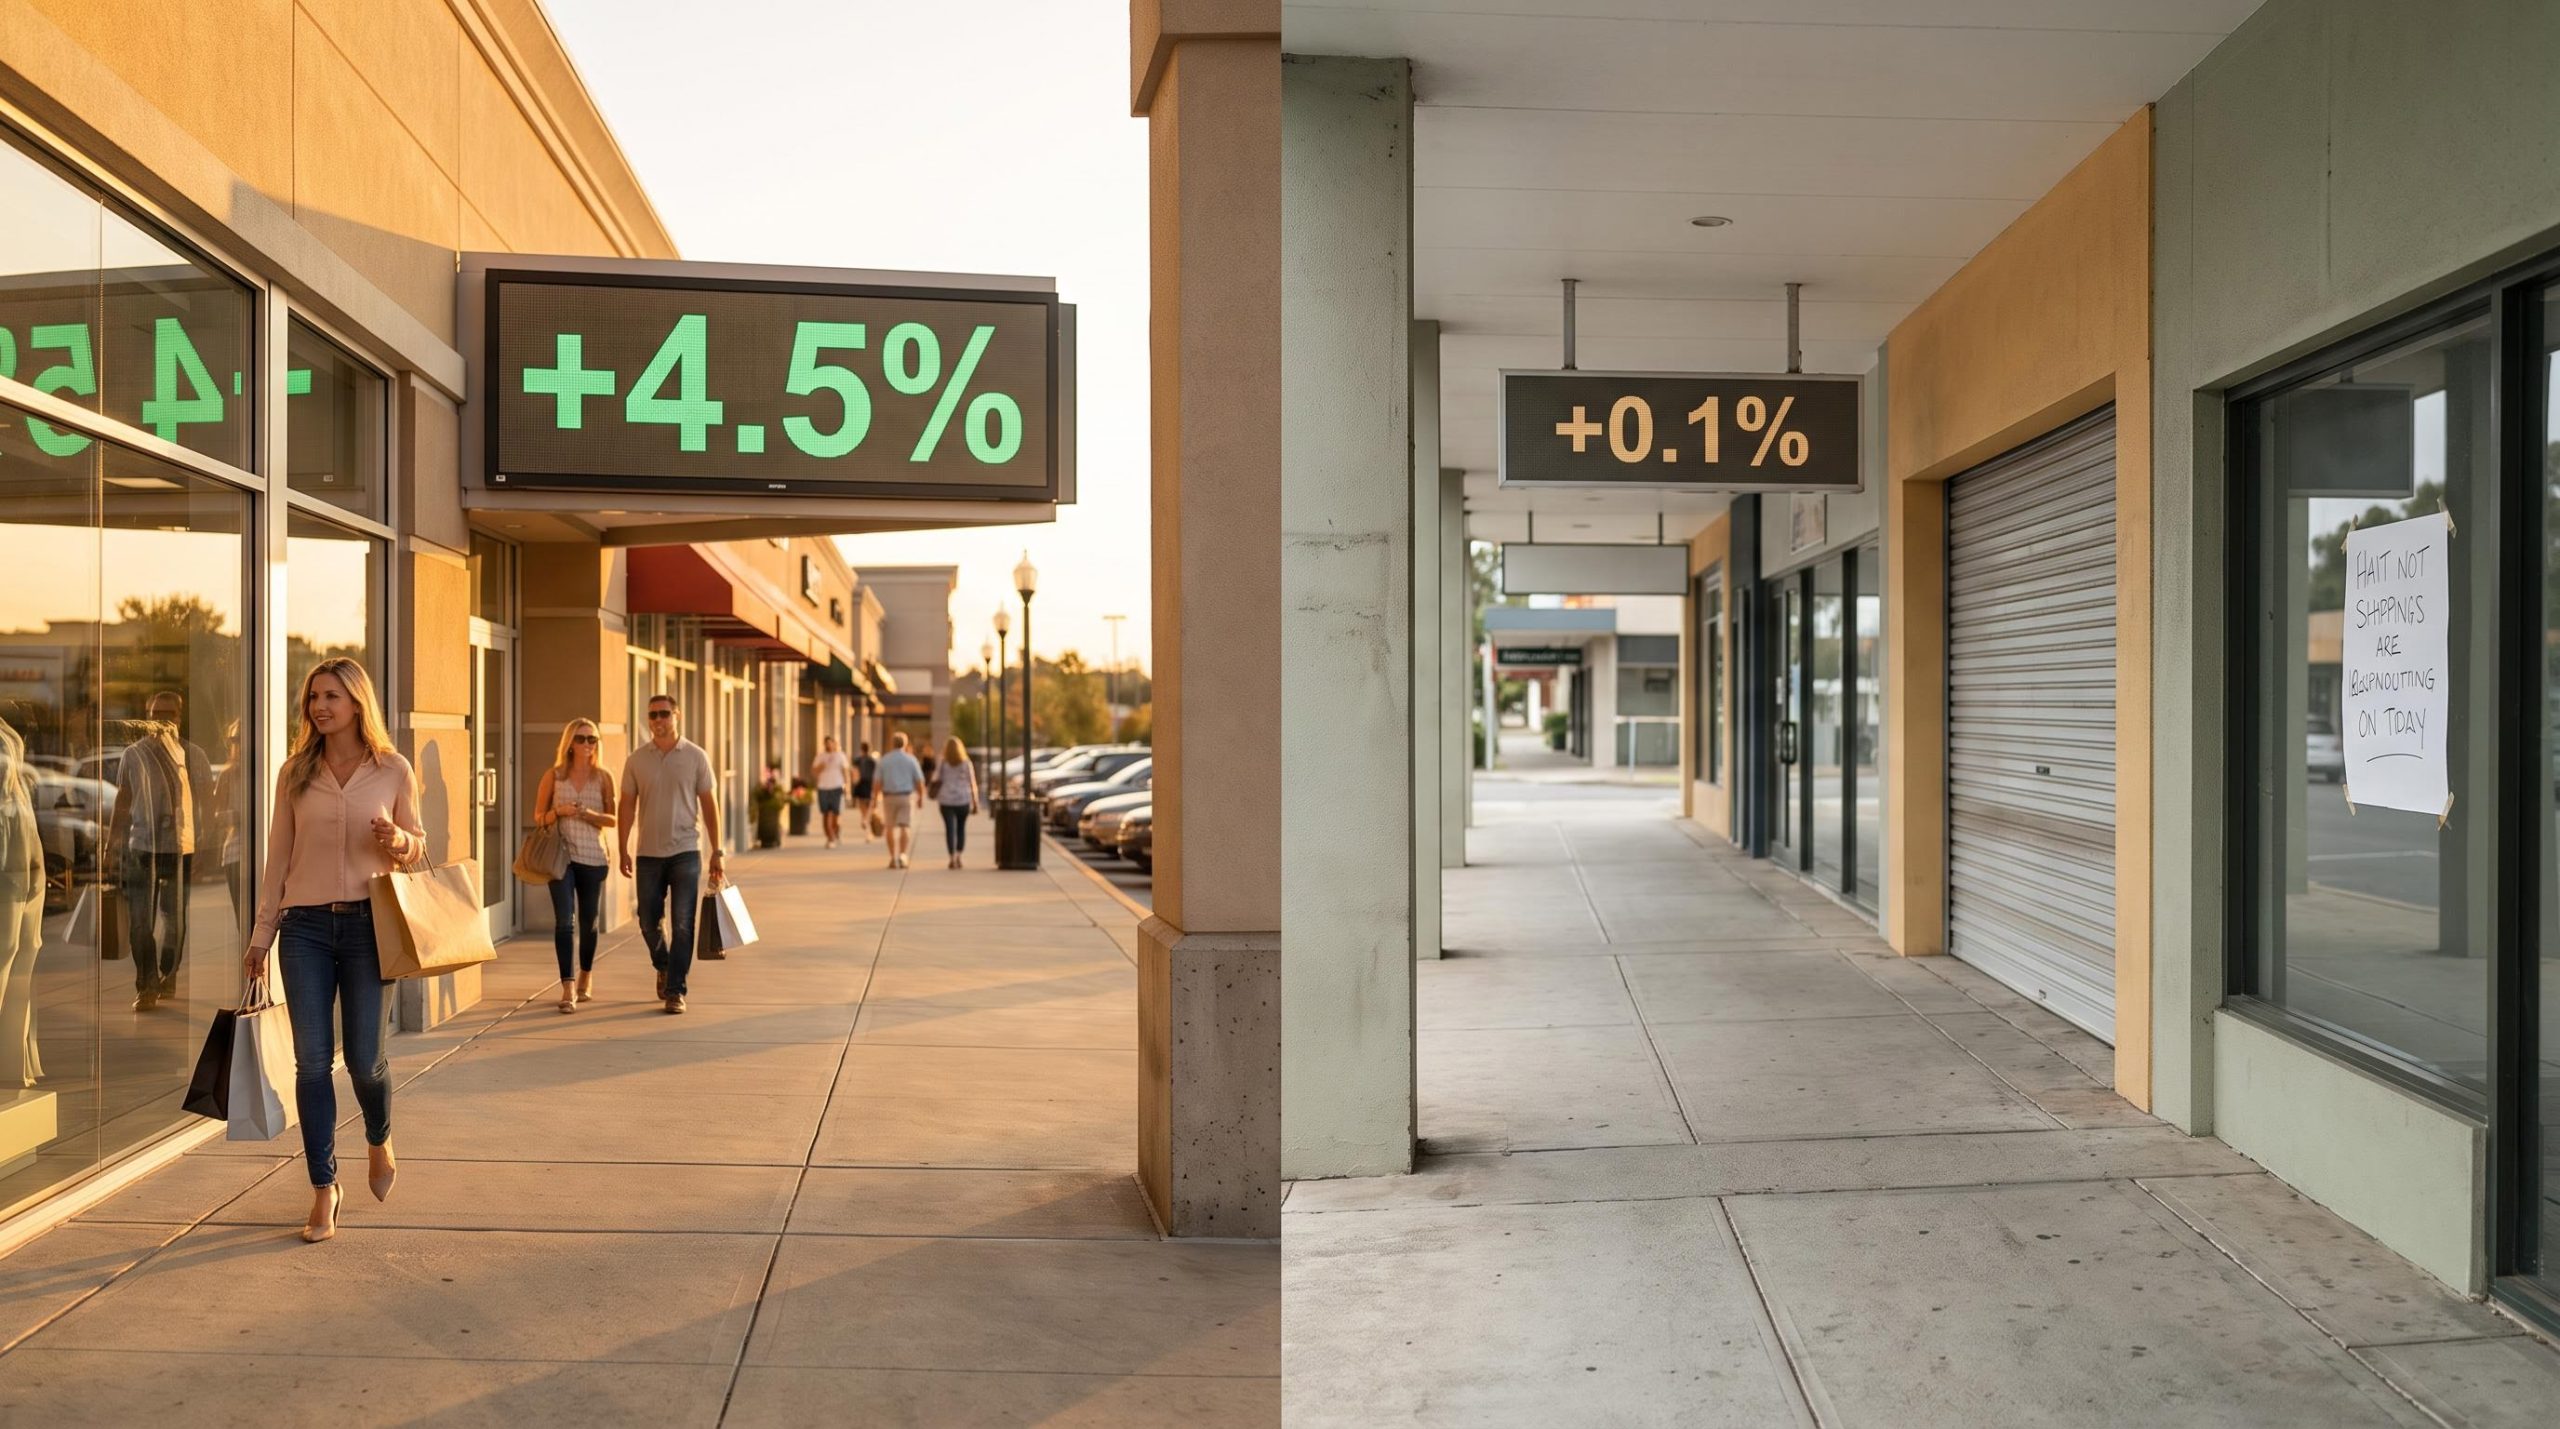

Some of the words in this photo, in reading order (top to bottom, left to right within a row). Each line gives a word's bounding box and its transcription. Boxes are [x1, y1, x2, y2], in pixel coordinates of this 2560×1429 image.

[522, 314, 1023, 465] +4.5%
[1555, 395, 1810, 467] +0.1%
[2397, 545, 2430, 580] NOT
[2376, 634, 2402, 657] ARE
[2358, 709, 2377, 738] ON
